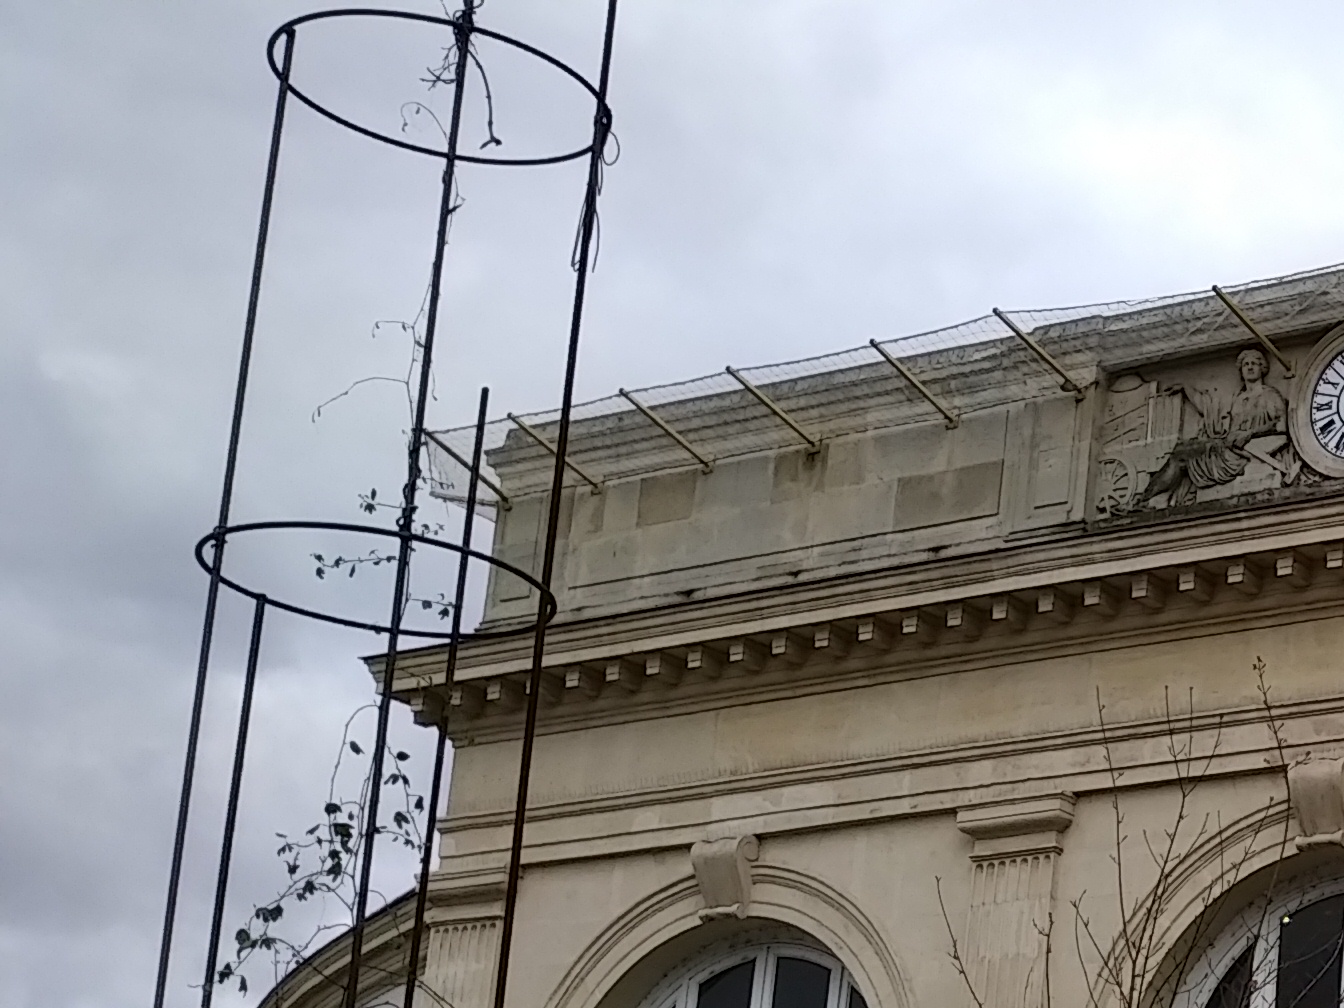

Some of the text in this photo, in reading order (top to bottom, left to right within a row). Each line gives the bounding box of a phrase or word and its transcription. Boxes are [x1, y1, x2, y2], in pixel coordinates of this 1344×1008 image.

[1323, 377, 1340, 390] X
[1316, 400, 1333, 412] IX
[1319, 418, 1336, 439] VIII
